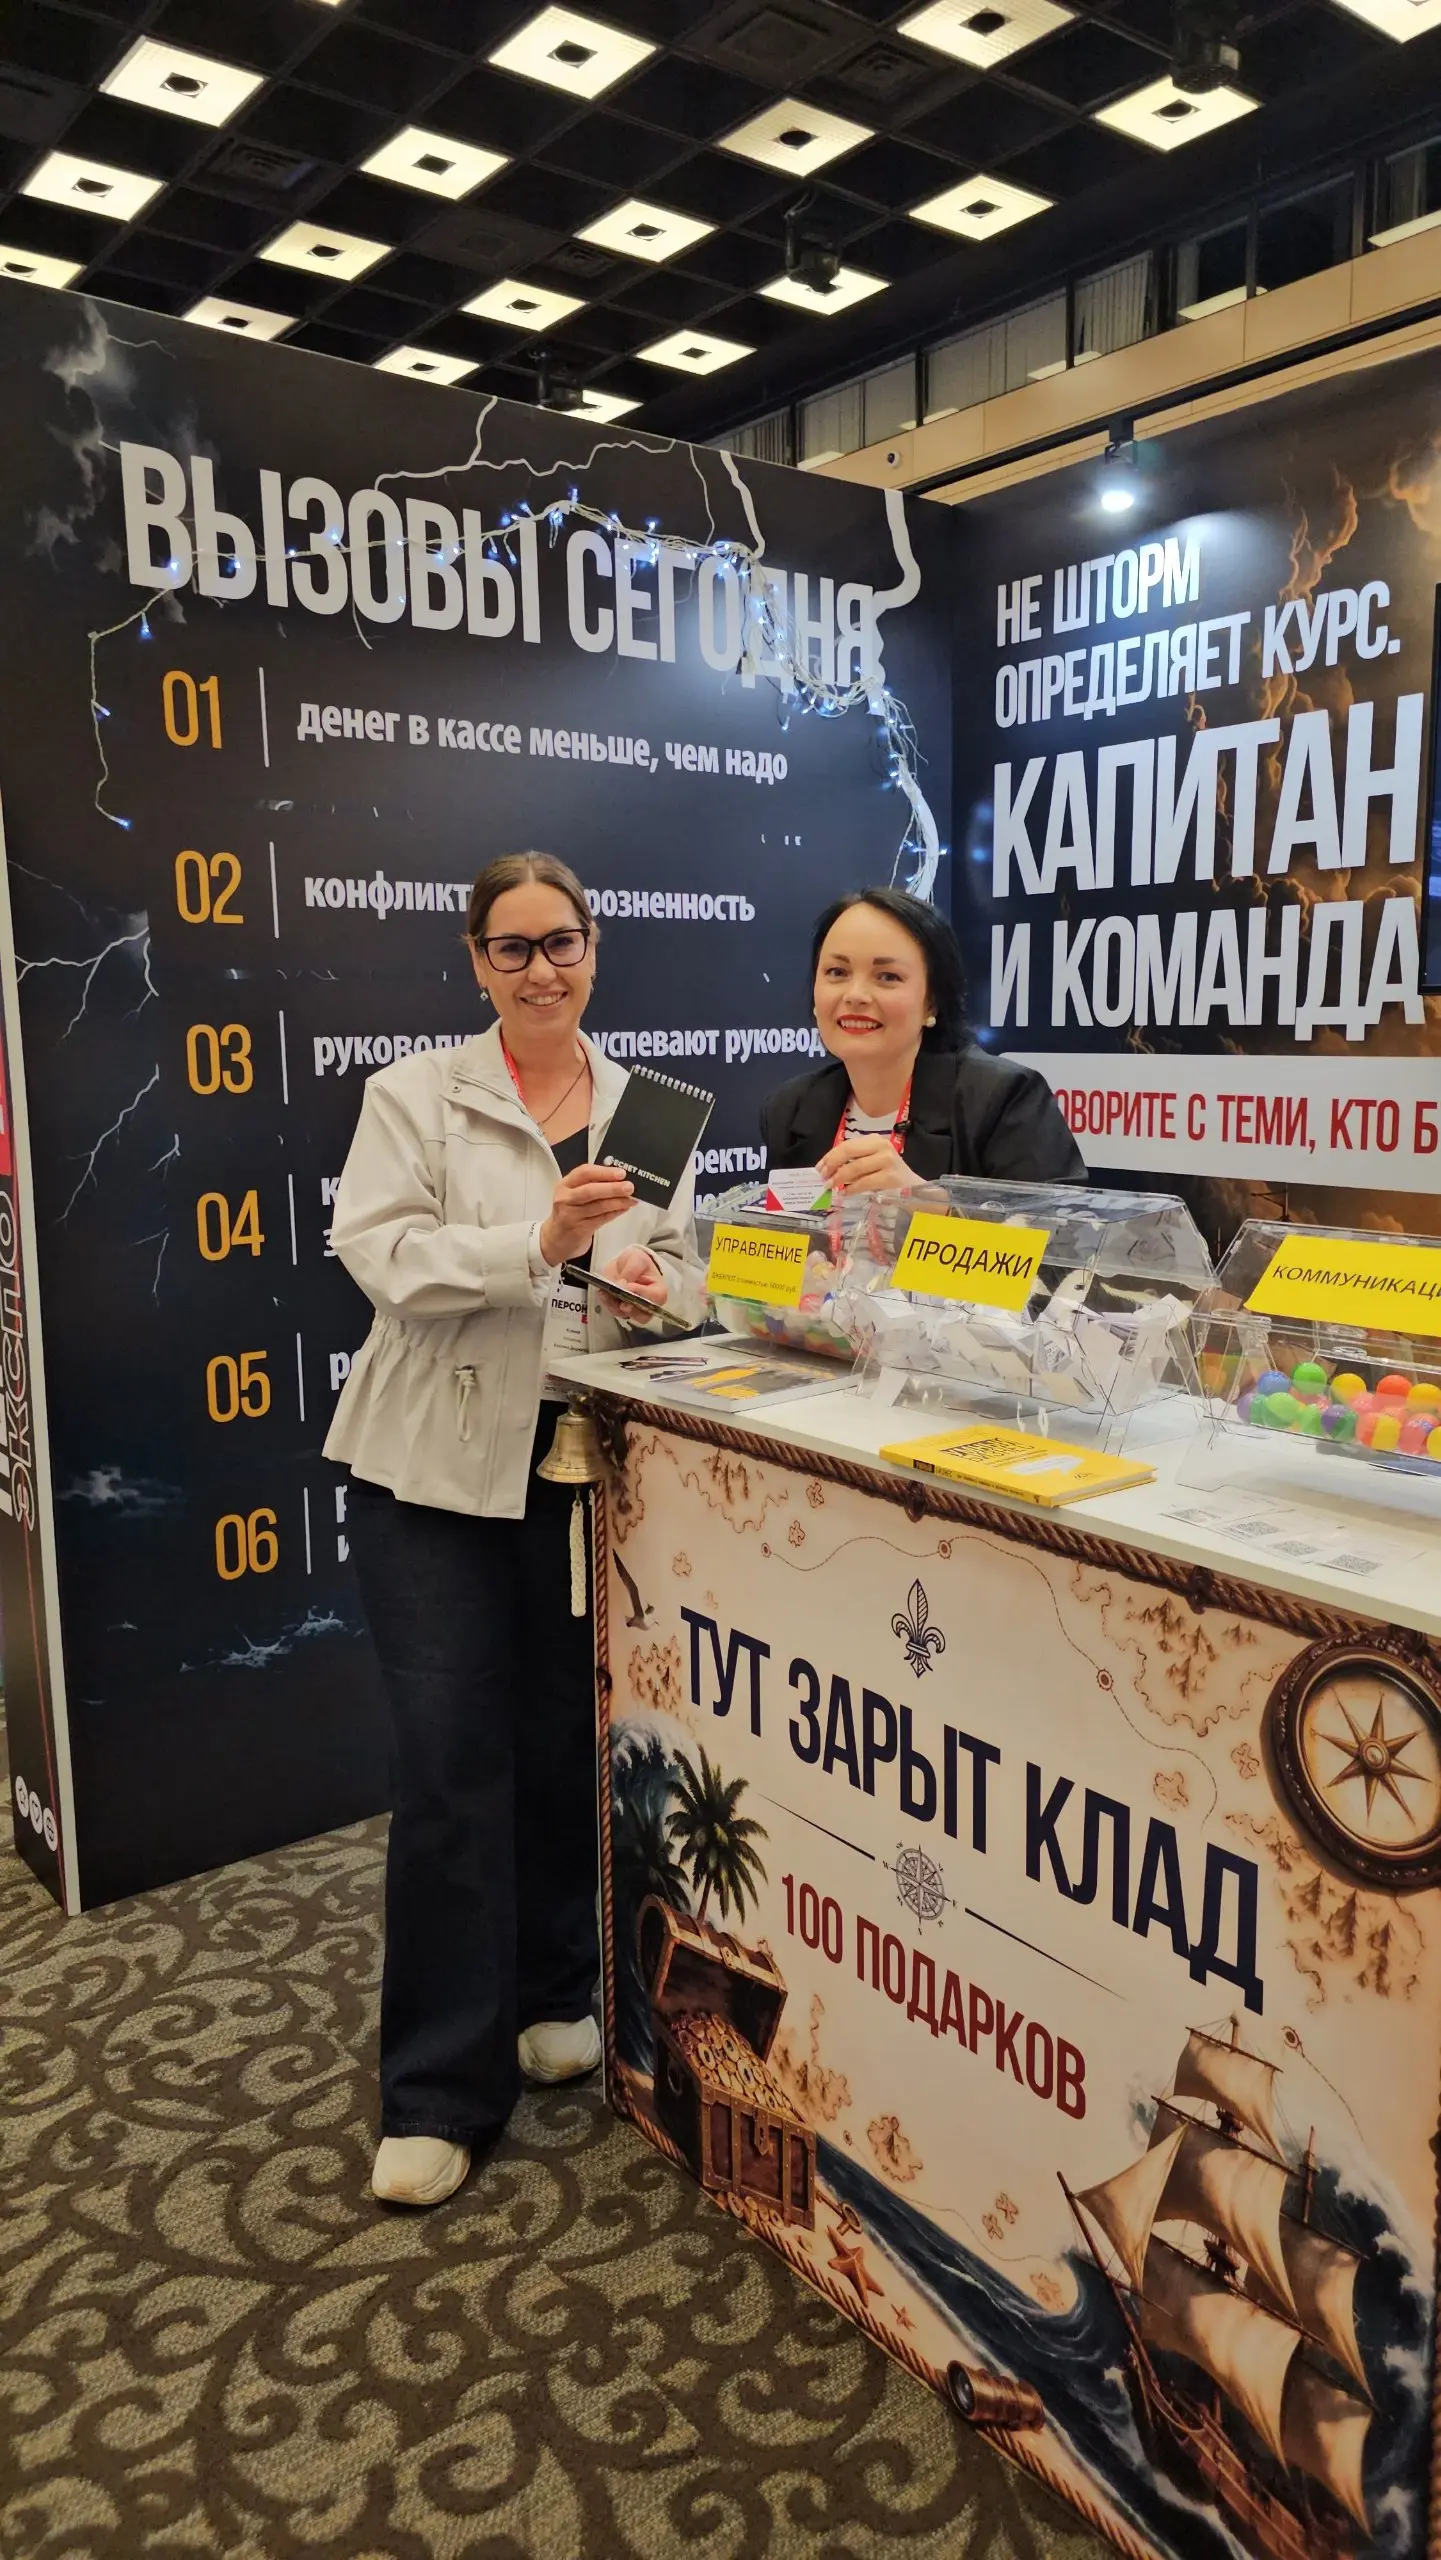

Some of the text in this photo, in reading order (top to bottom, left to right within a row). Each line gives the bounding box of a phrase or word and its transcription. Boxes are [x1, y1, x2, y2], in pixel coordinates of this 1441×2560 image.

[119, 441, 874, 695] ВЫЗОВЫ СЕГОДНЯ
[998, 535, 1201, 647] НЕ ШТОРМ
[995, 581, 1399, 728] ОПРЕДЕЛЯЕТ КУРС.
[162, 670, 222, 748] 01
[297, 702, 788, 785] денег в кассе меньше, чем надо
[992, 692, 1424, 898] КАПИТАН
[175, 850, 243, 924] 02
[304, 870, 756, 922] конфликт розненность
[990, 896, 1425, 1042] И КОМАНДА
[186, 1024, 254, 1094] 03
[725, 1027, 825, 1063] руковод
[1054, 1089, 1177, 1139] ОВОРИТЕ
[1187, 1093, 1206, 1141] С
[1217, 1094, 1316, 1154] ТЕМИ,
[1330, 1098, 1400, 1153] КТО
[638, 1169, 671, 1187] KITCHEN
[197, 1190, 264, 1261] 04
[716, 1236, 803, 1264] УПРАВЛЕНИЕ
[907, 1238, 1033, 1278] ПРОДАЖИ
[207, 1351, 271, 1422] 05
[215, 1508, 278, 1580] 06
[680, 1606, 1264, 2015] ТУТ ЗАРЫТ КЛАД
[782, 1873, 1087, 2120] 100 ПОДАРКОВ
